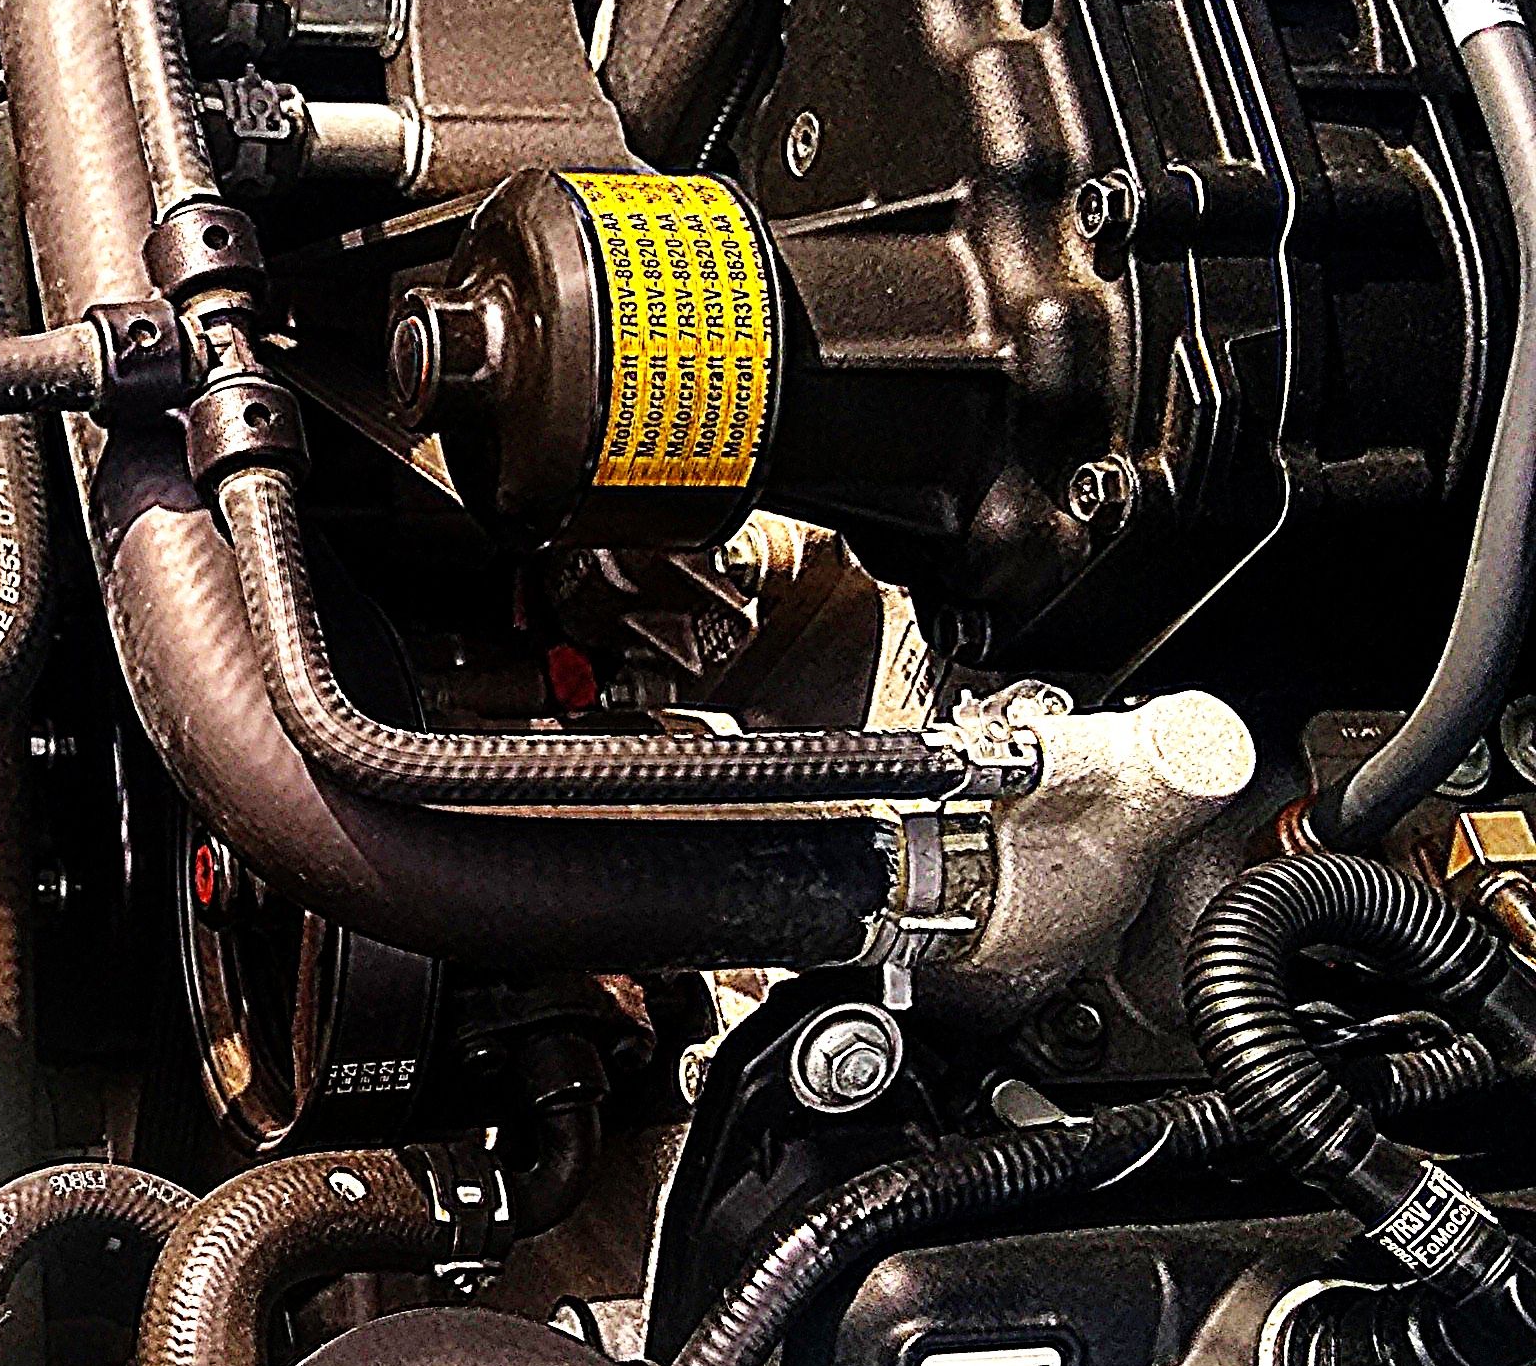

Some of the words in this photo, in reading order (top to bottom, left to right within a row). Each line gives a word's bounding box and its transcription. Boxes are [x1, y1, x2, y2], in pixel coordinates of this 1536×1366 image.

[599, 212, 638, 339] 7R3V-8620-AA
[628, 213, 667, 340] 7R3V-8620-AA
[656, 214, 696, 340] 7R3V-8620-AA
[684, 214, 724, 341] 7R3V-8620-AA
[712, 215, 752, 341] 7R3V-8620-AA
[607, 354, 639, 457] Motorcraft
[636, 354, 668, 457] Motorcraft
[665, 355, 696, 457] Motorcraft
[693, 355, 725, 457] Motorcraft
[720, 356, 753, 457] Motorcraft
[1414, 1203, 1473, 1263] FoMoCo
